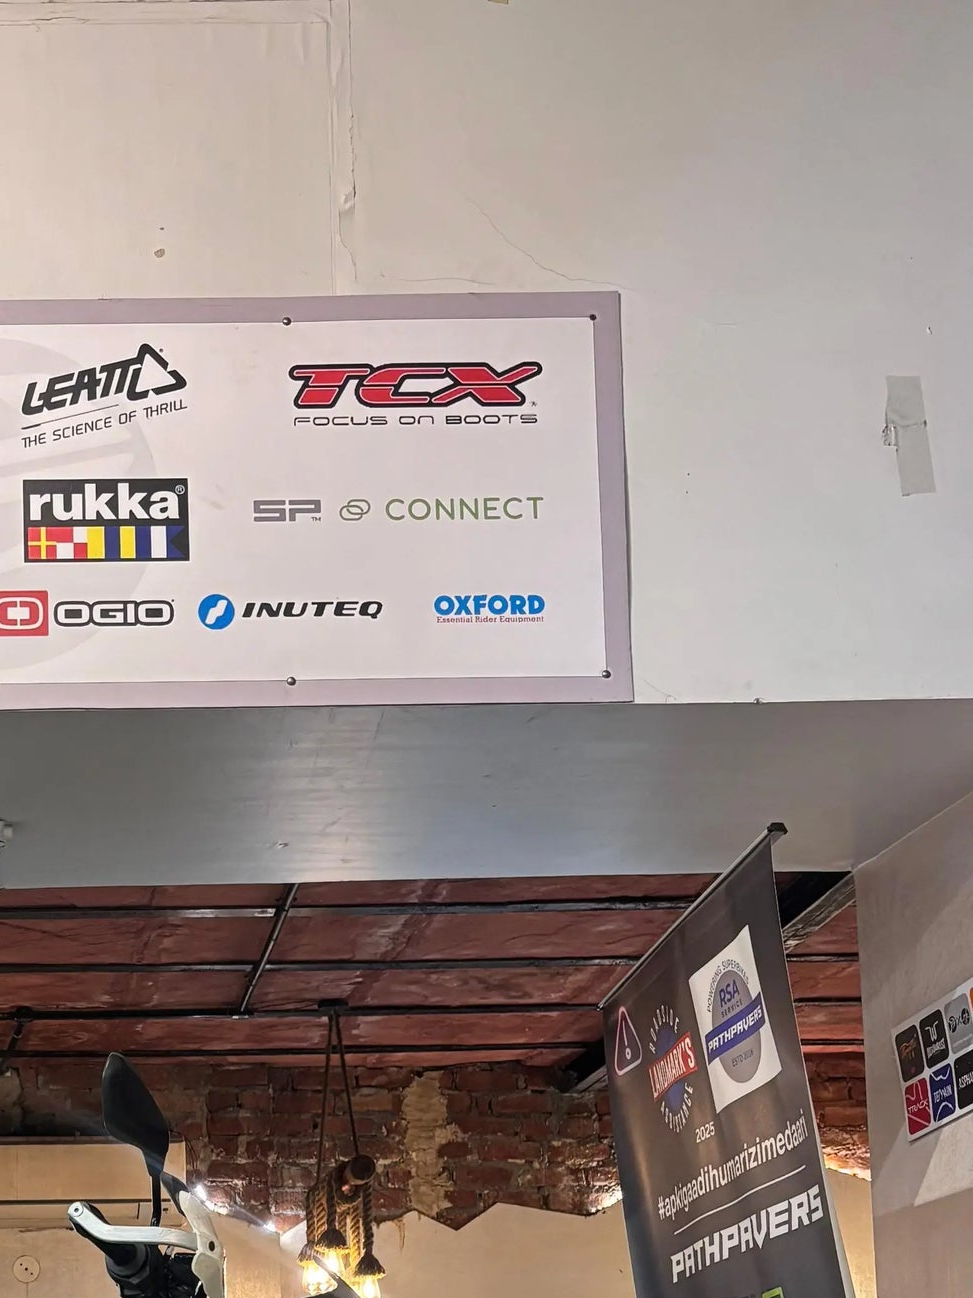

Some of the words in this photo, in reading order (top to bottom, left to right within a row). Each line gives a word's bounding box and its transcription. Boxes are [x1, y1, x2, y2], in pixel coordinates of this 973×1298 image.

[289, 362, 543, 408] TCX
[22, 433, 47, 448] THE
[52, 416, 112, 442] SCIENCE
[118, 411, 139, 426] OF
[142, 399, 188, 421] THRILL
[293, 415, 390, 426] FOCUS
[445, 414, 538, 425] BOOTS
[30, 483, 180, 521] rukka
[384, 496, 544, 521] CONNECT
[54, 600, 175, 627] OGIO
[241, 600, 383, 621] INUTEQ
[433, 594, 545, 616] OXFORD
[436, 615, 473, 624] Essential
[475, 615, 497, 624] Rider
[499, 614, 545, 626] Equipment
[718, 979, 740, 1008] RSA
[721, 1000, 744, 1018] SERVICE
[649, 1004, 680, 1055] ROADSIDE
[707, 1006, 763, 1052] PATHPAVERS
[650, 1037, 696, 1098] LANDMARK'S
[695, 1121, 716, 1144] 2025
[670, 1184, 826, 1284] PATHPAVERS
